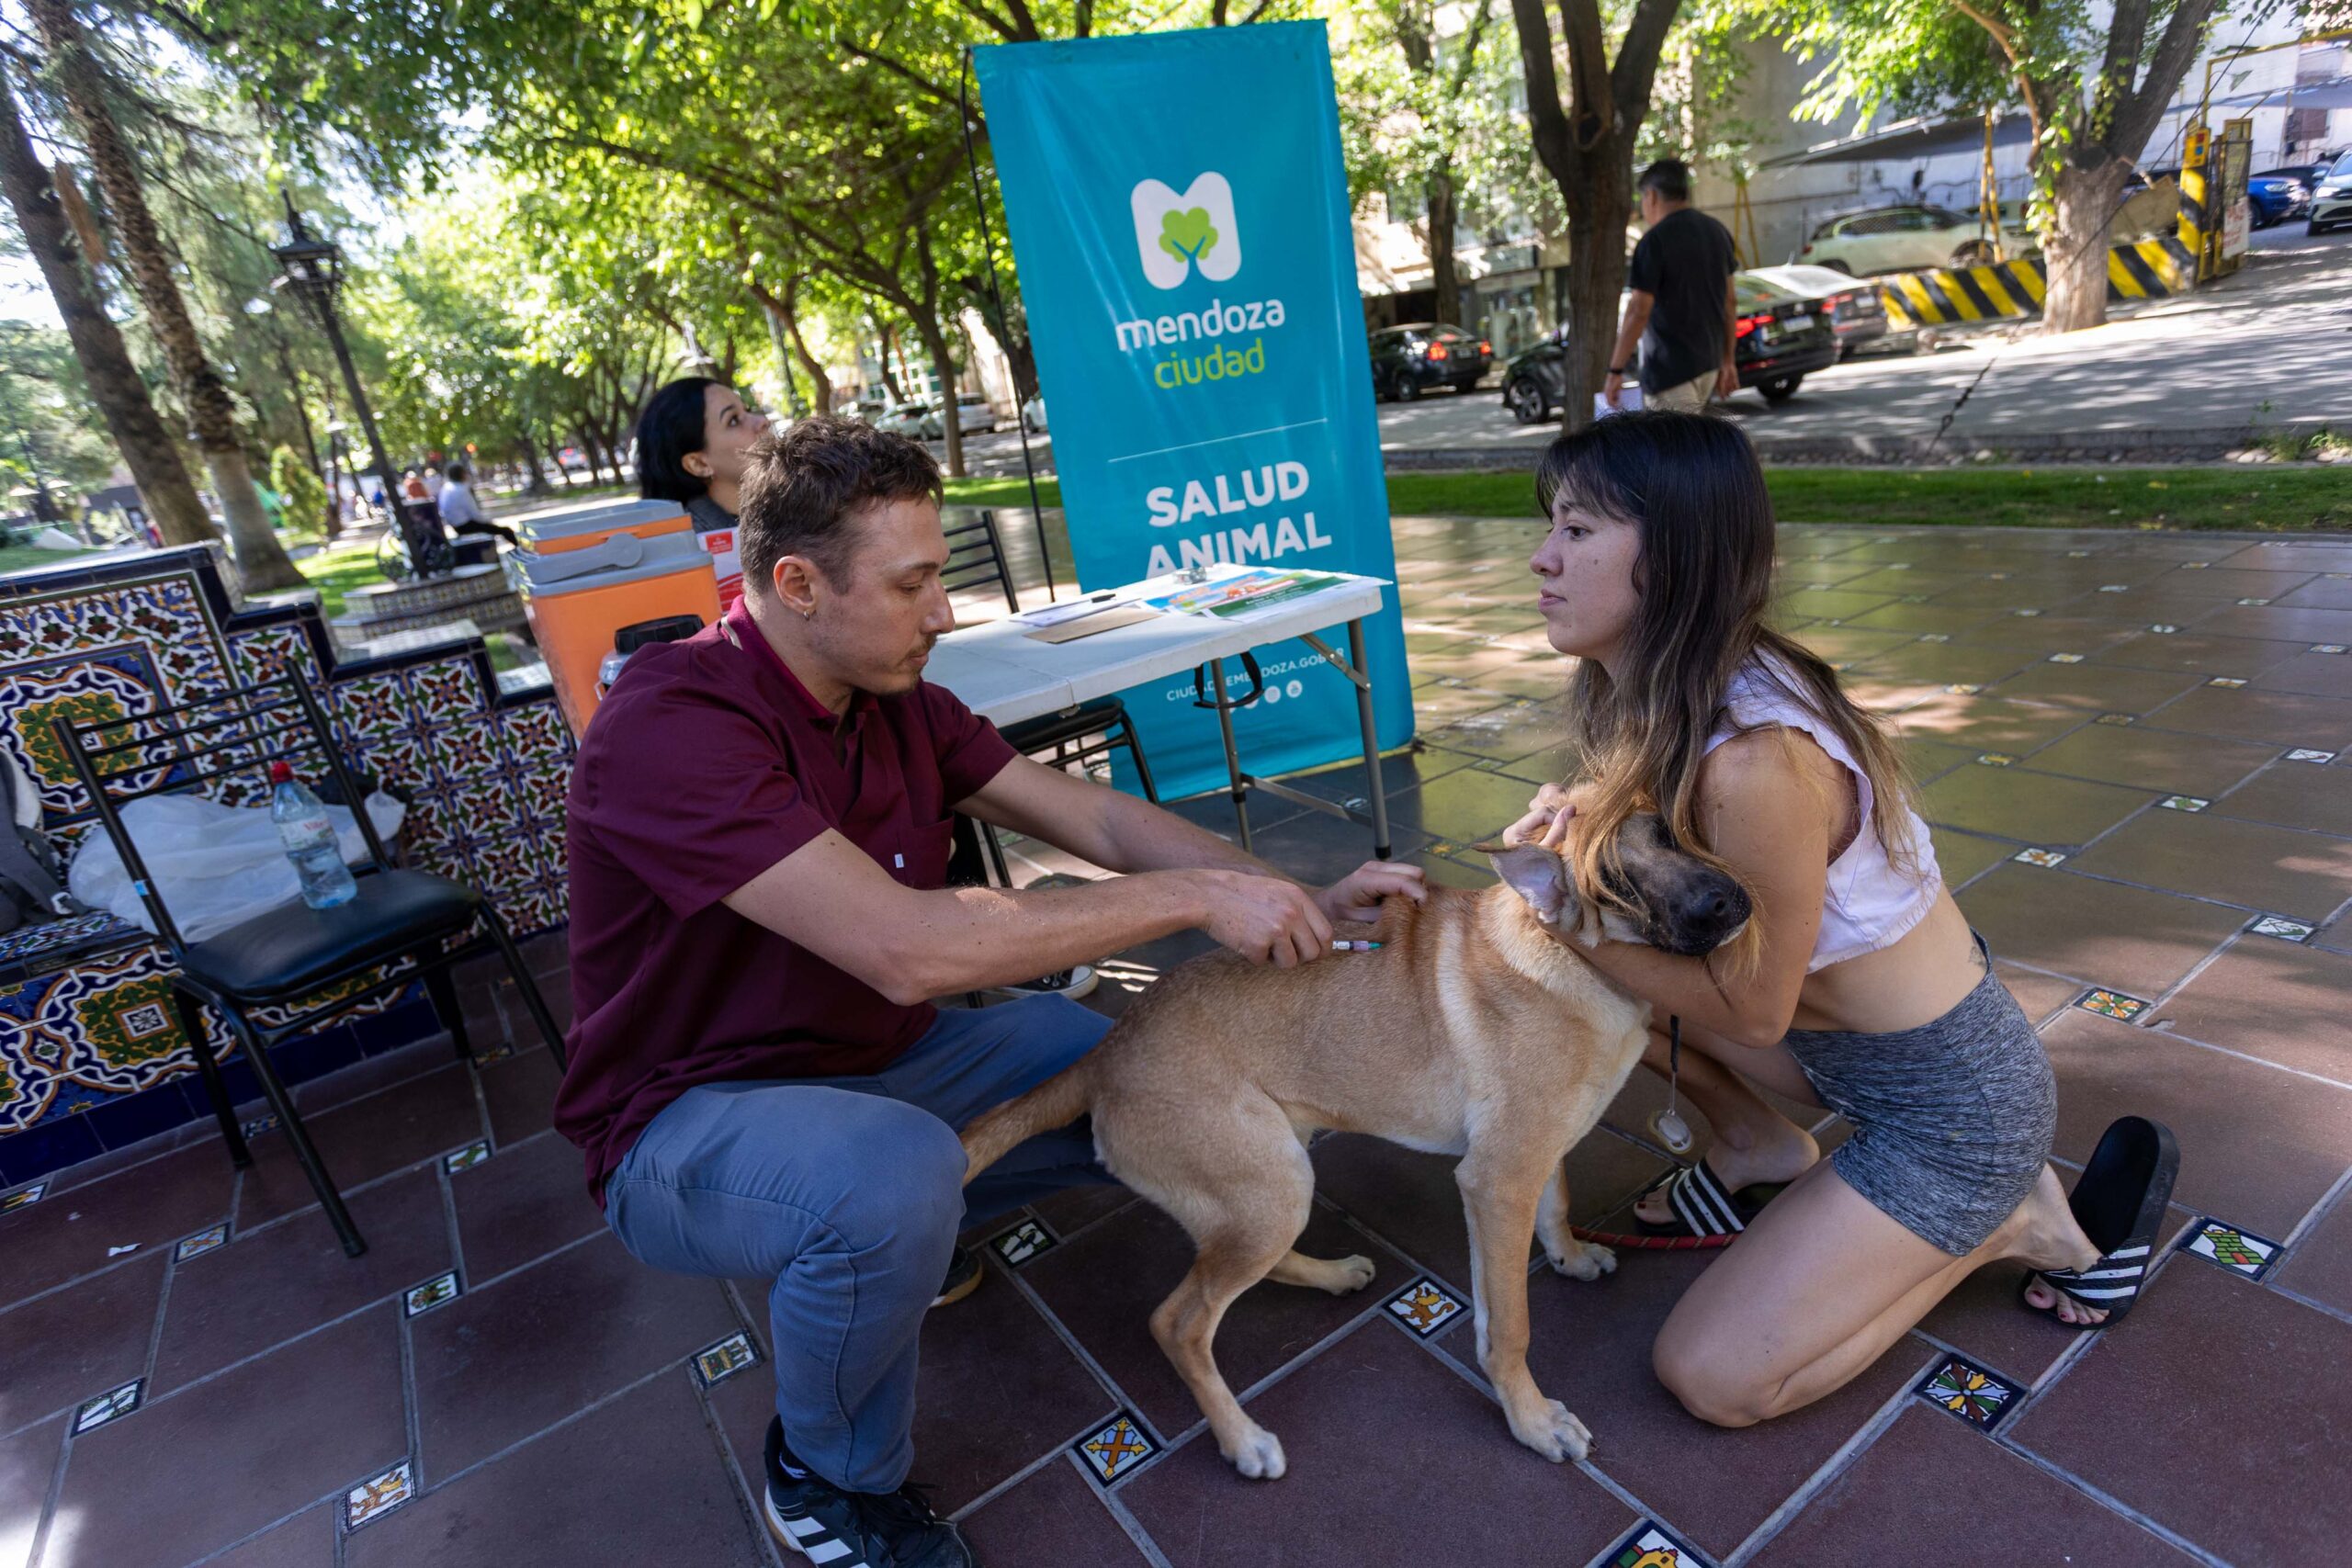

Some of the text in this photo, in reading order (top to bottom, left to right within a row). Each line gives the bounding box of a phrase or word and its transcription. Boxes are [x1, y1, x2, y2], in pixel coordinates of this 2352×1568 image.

[1115, 299, 1285, 352] mendoza
[1154, 337, 1265, 389] ciudad
[1146, 461, 1309, 527] SALUD
[1146, 512, 1332, 580] ANIMAL
